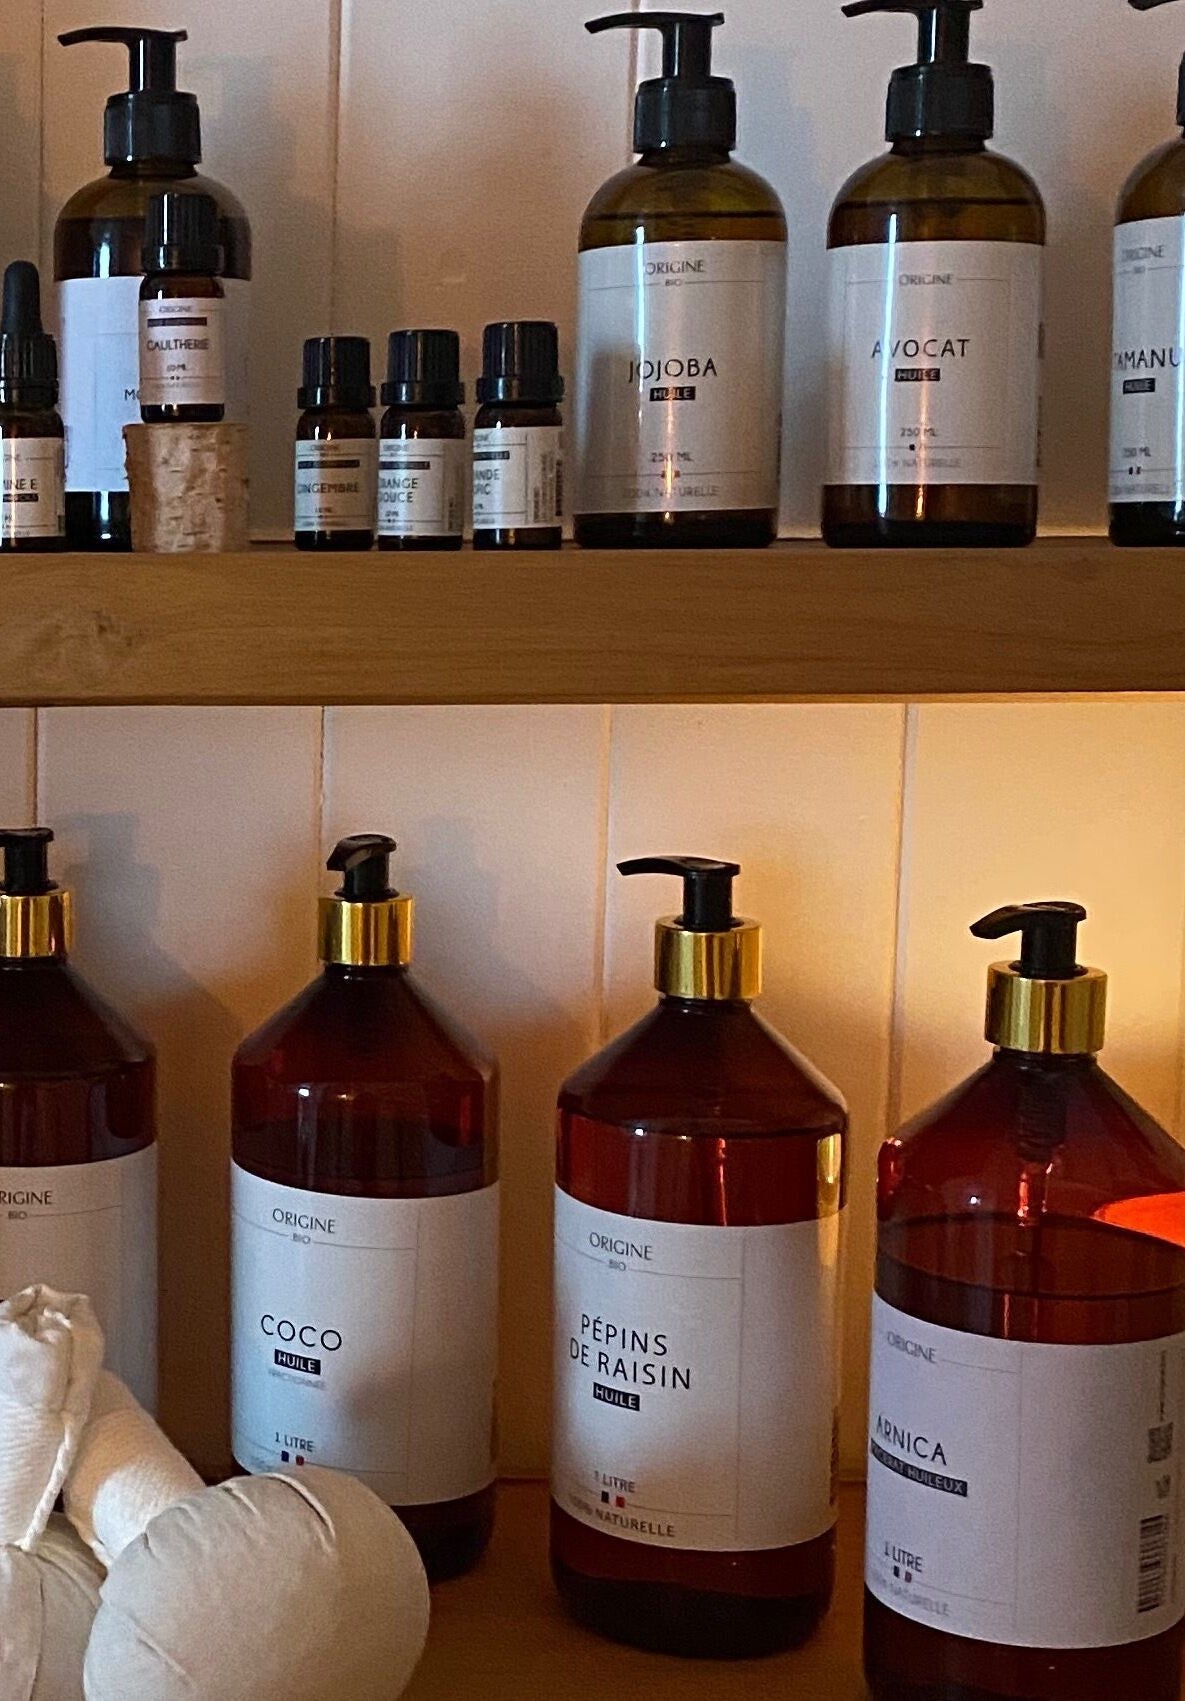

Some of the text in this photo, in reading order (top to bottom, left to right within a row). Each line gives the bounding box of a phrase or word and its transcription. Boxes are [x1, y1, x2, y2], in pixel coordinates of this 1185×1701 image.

[644, 259, 706, 275] ORIGINE
[898, 273, 954, 287] ORIGINE
[871, 338, 971, 359] AVOCAT
[628, 357, 719, 384] JOJOBA
[896, 369, 939, 381] HUILE
[654, 387, 692, 400] HUILE
[272, 1207, 336, 1235] ORIGINE
[291, 1232, 312, 1245] BIO
[588, 1231, 654, 1262] ORIGINE
[260, 1314, 343, 1352] COCO
[580, 1313, 669, 1357] PÉPINS
[886, 1330, 938, 1365] ORIGINE
[277, 1351, 317, 1374] HUILE
[569, 1337, 691, 1391] DE RAISIN
[594, 1384, 638, 1409] HUILE
[283, 1434, 315, 1453] LITRE
[875, 1414, 948, 1466] ARNICA
[602, 1473, 637, 1493] LITRE
[907, 1465, 964, 1494] HUILEUX
[595, 1508, 676, 1538] NATURELLE
[892, 1545, 923, 1573] LITRE
